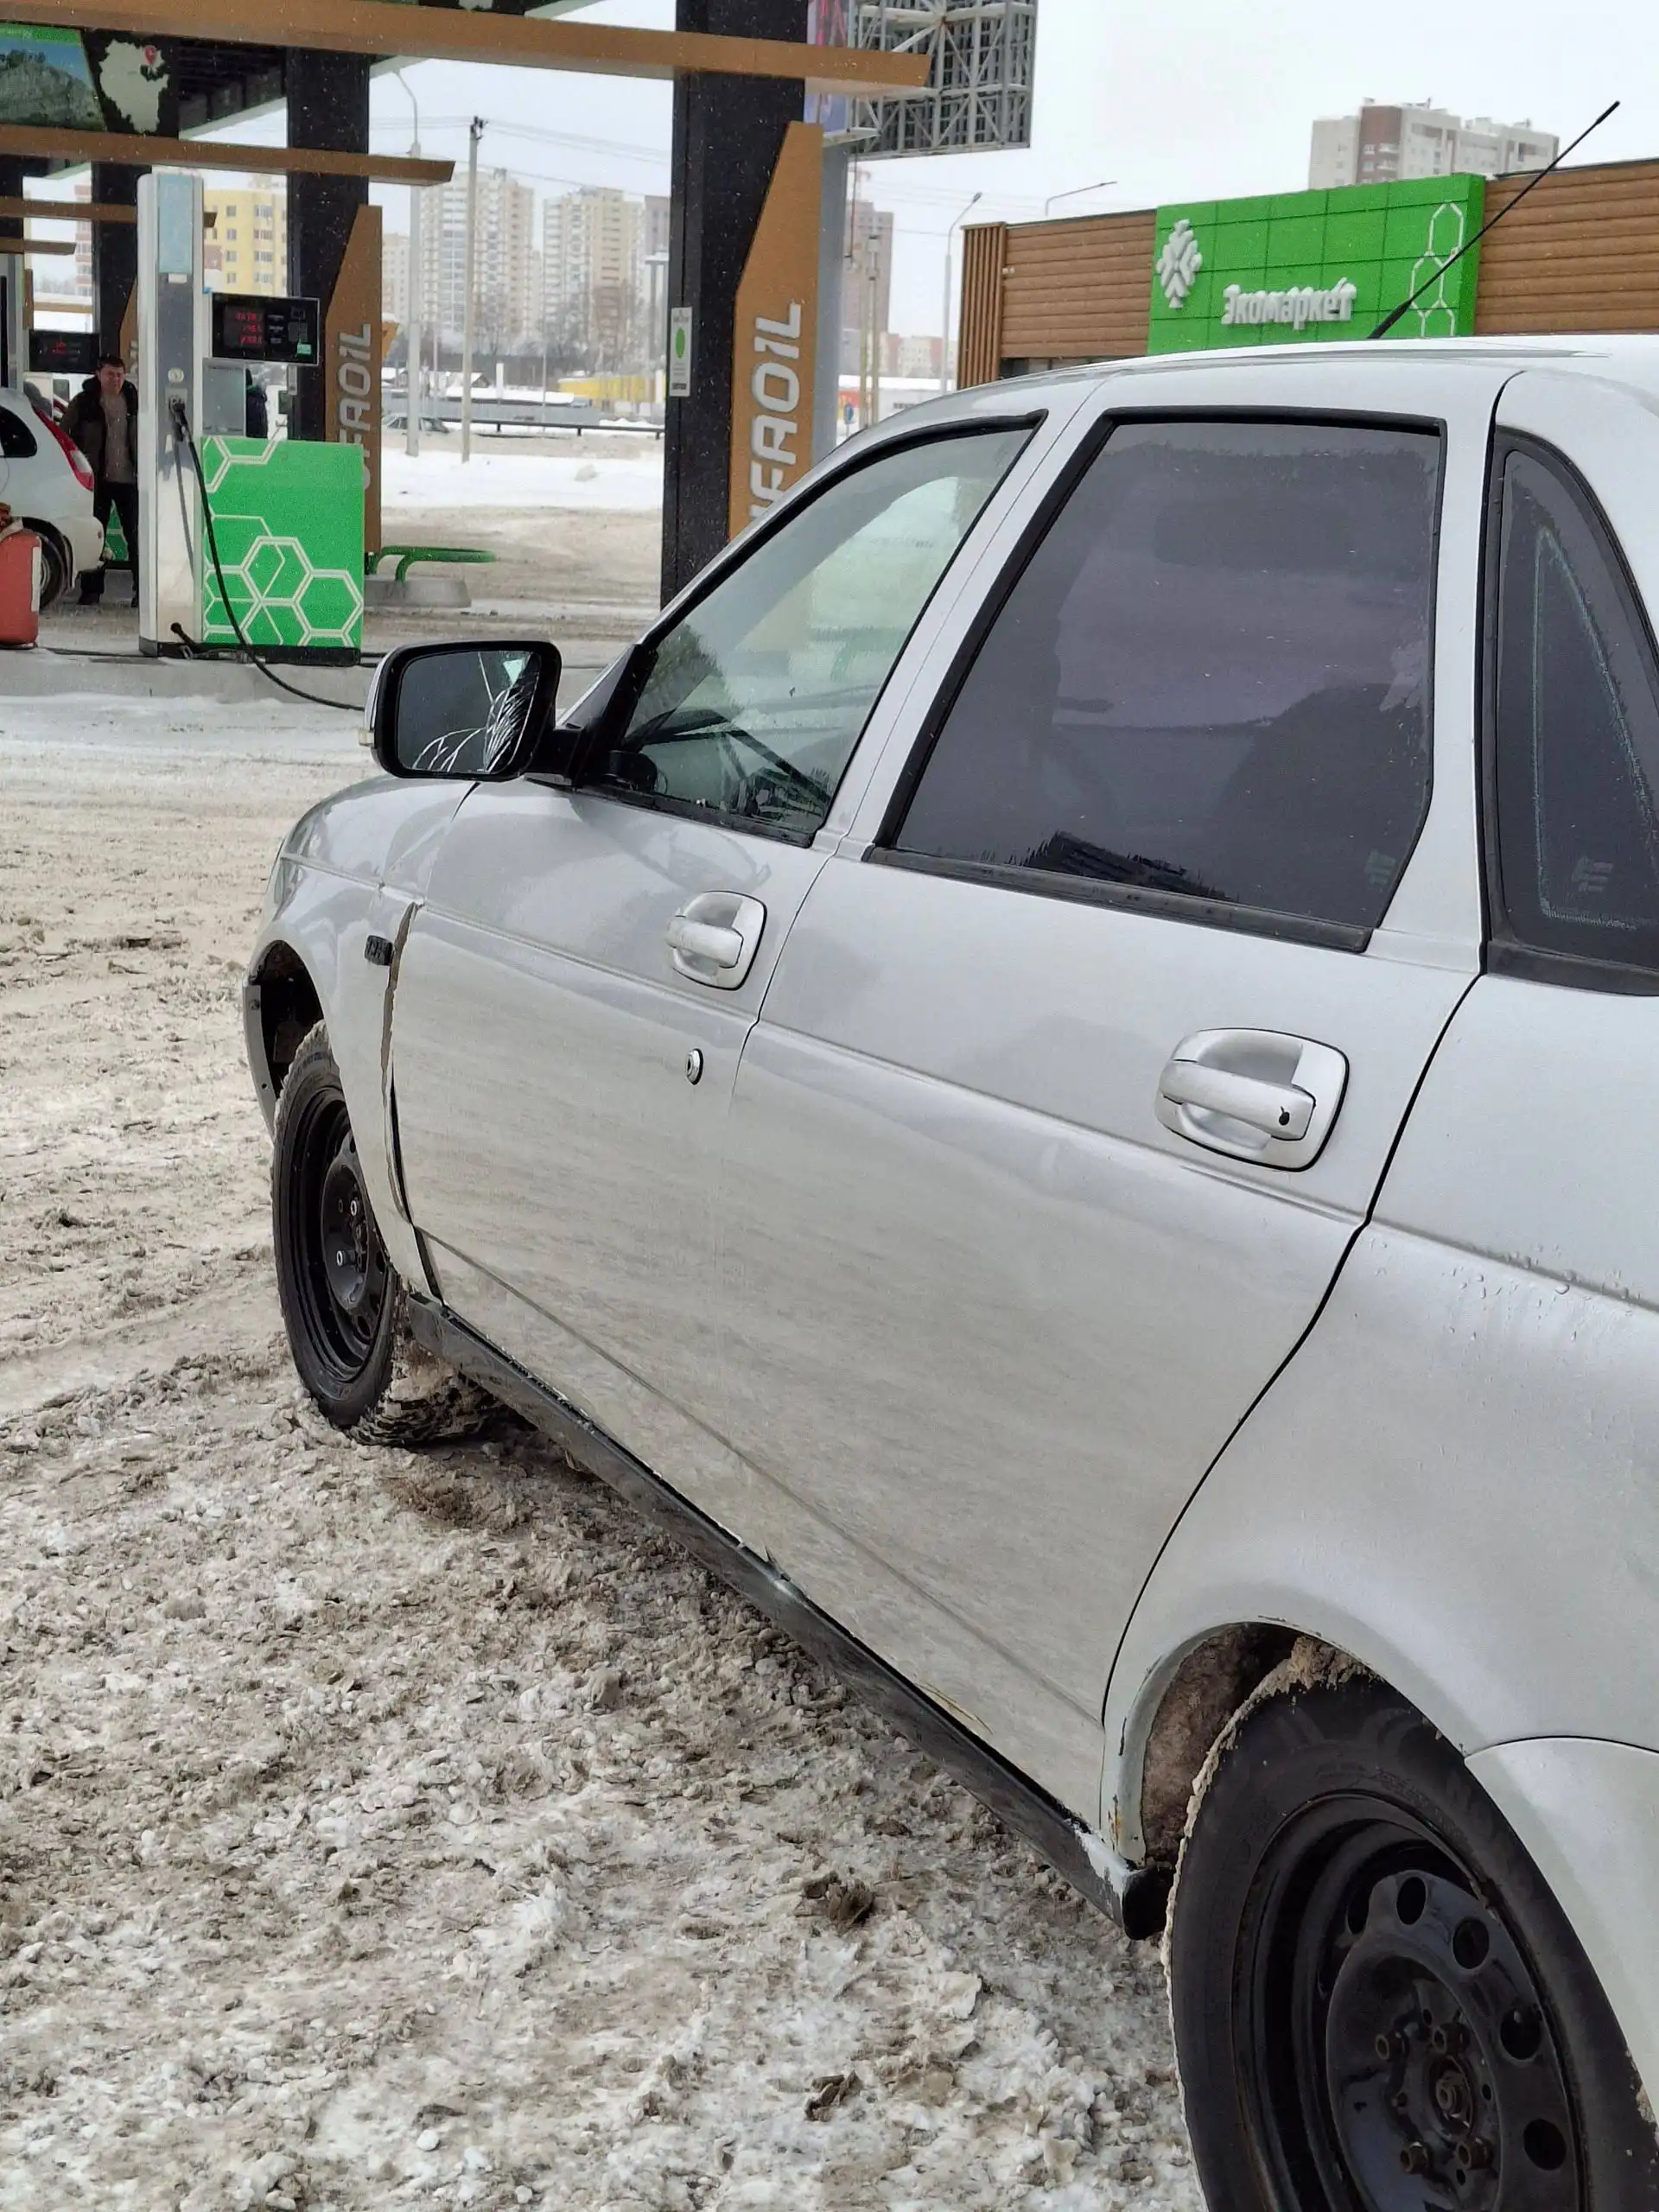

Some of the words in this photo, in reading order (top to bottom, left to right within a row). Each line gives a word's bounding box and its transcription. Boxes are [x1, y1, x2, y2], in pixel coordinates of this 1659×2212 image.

[1221, 283, 1357, 330] Экомаркет
[338, 323, 372, 490] AOIL
[749, 302, 803, 519] FAOIL
